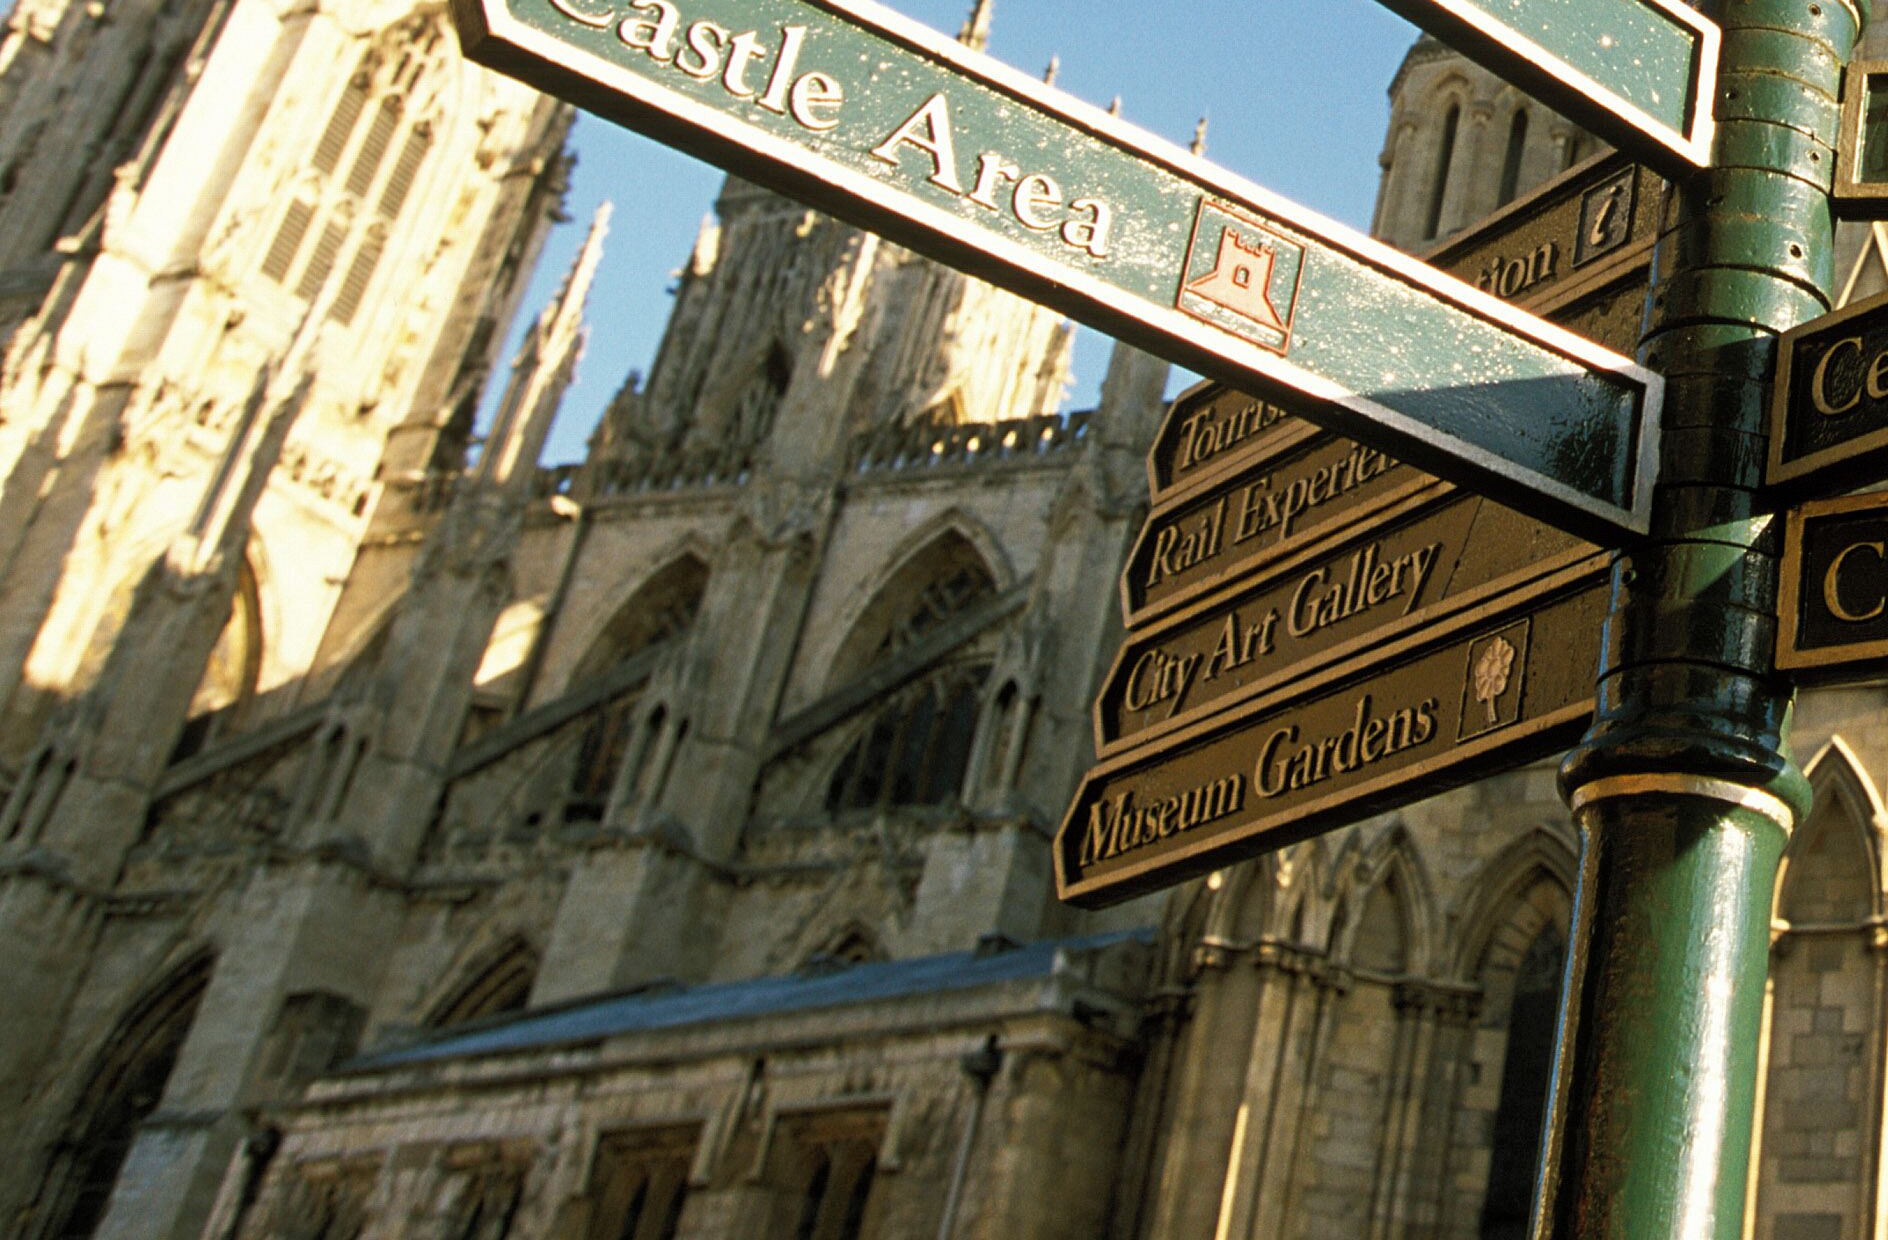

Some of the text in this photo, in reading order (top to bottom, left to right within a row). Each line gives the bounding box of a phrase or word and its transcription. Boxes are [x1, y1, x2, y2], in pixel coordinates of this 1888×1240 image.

[869, 91, 1112, 258] Area
[1179, 400, 1287, 471] Touris
[1146, 495, 1229, 588] Rail
[1124, 540, 1444, 719] City Art Gallery
[1078, 695, 1437, 867] Museum Gardens
